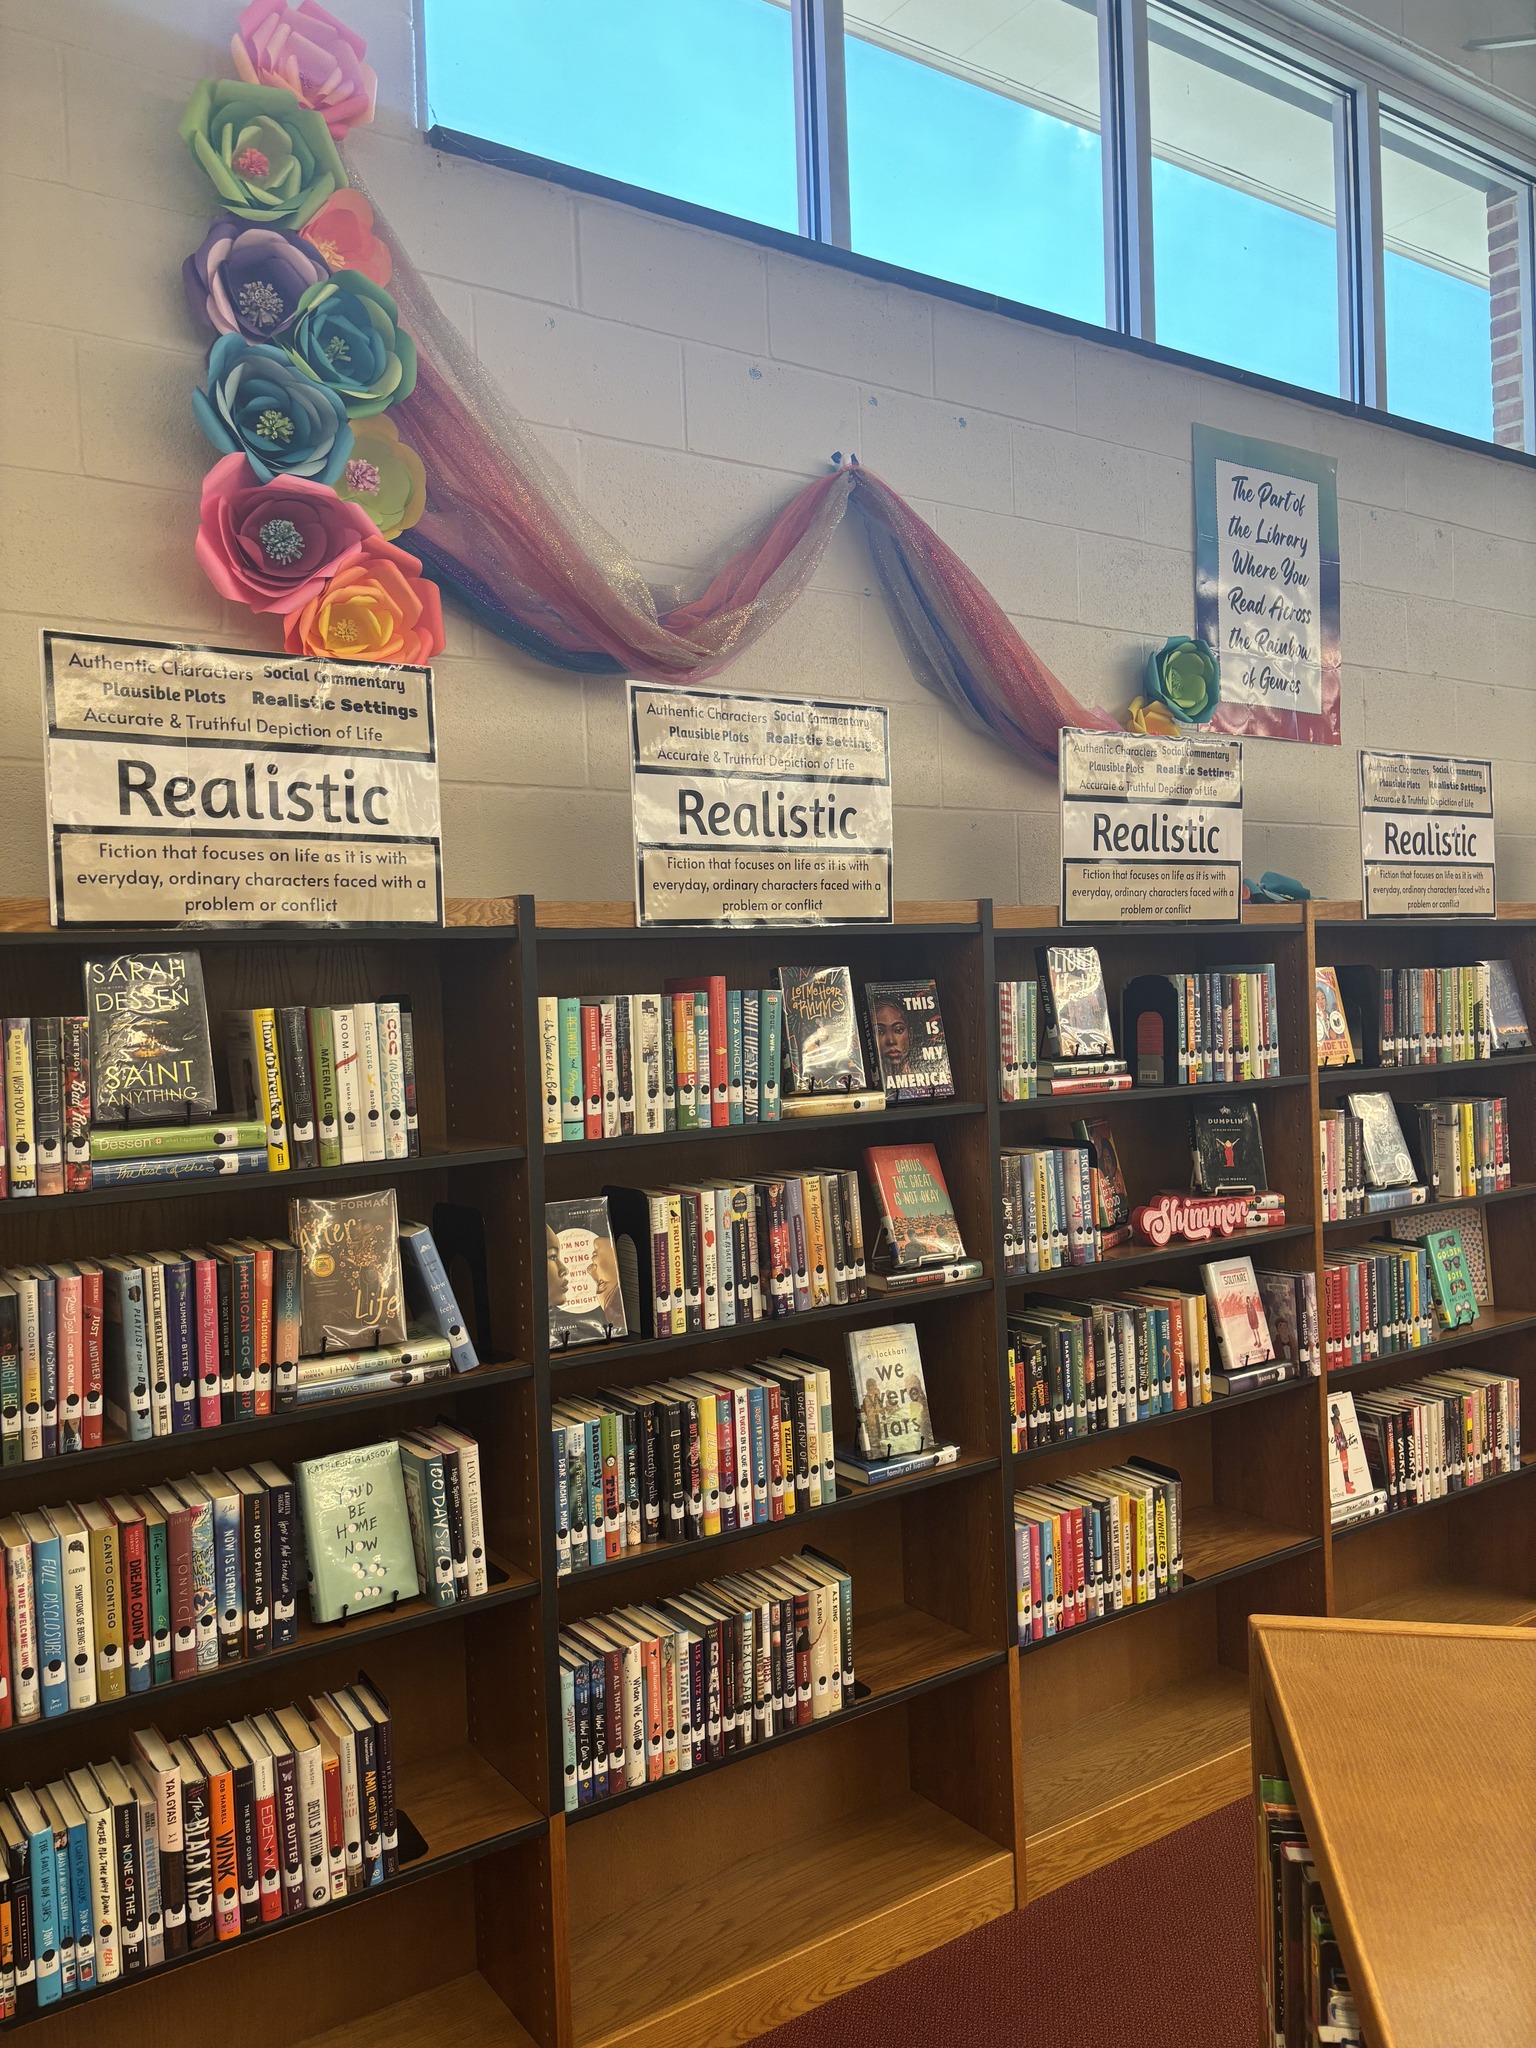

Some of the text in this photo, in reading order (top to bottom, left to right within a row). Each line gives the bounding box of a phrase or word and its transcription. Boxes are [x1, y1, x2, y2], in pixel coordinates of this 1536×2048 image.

[1231, 476, 1306, 516] The Part of
[1228, 515, 1307, 558] the Library
[1232, 549, 1309, 587] Where You
[1228, 586, 1312, 625] Read Across
[1228, 627, 1310, 660] the Rainbow
[69, 652, 405, 694] Authentic Characters Social Commentary
[1243, 666, 1300, 694] of Genres
[103, 682, 418, 719] Plausible Plots Realistic Settings
[84, 708, 382, 741] Accurate & Truthful Depiction of Life
[647, 703, 869, 729] Authentic Characters Social Commentary
[670, 727, 878, 752] Plausible Plots Realistic Settings
[658, 750, 854, 770] Accurate & Truthful Depiction of Life
[118, 759, 389, 825] Realistic
[679, 789, 857, 839] Realistic
[1094, 813, 1220, 853] Realistic
[1385, 822, 1476, 856] Realistic
[100, 843, 407, 865] Fiction that focuses on life as it is with
[668, 857, 869, 871] Fiction that focuses on life as it is with
[77, 870, 426, 889] everyday, ordinary characters faced with a
[653, 879, 881, 893] everyday, ordinary characters faced with a
[1083, 869, 1110, 880] Fiction
[1112, 870, 1128, 880] that
[1130, 870, 1159, 880] focuses
[1172, 870, 1184, 880] life
[1196, 870, 1201, 881] it
[1203, 870, 1209, 881] is
[1211, 870, 1225, 881] with
[185, 896, 337, 915] problem or conflict
[722, 900, 823, 913] problem or conflict
[1121, 905, 1152, 916] problem
[1165, 905, 1191, 914] conflict
[92, 958, 185, 983] SARAH
[96, 988, 189, 1012] DESSEN
[904, 997, 935, 1010] THIS
[341, 1015, 350, 1049] ROOM
[926, 1022, 939, 1034] IS
[922, 1047, 943, 1060] MY
[106, 1060, 193, 1089] SAINT
[262, 1020, 283, 1111] how to break
[320, 1049, 332, 1099] MATERIAL
[887, 1073, 948, 1089] AMERICA
[108, 1087, 198, 1106] ANYTHING
[100, 1136, 152, 1151] Dessen
[895, 1159, 922, 1172] DARIUS
[892, 1174, 932, 1189] THE GREAT
[300, 1199, 389, 1214] GAYLE FORMAN
[893, 1189, 940, 1206] IS NOT OKAY
[1141, 1198, 1249, 1244] Shimmer
[300, 1218, 356, 1253] After
[561, 1240, 589, 1250] I'M NOT
[564, 1254, 589, 1264] DYING
[1437, 1248, 1461, 1260] GOLDEN
[1224, 1273, 1247, 1285] SOLITAIRE
[1448, 1271, 1462, 1281] BOYS
[355, 1286, 400, 1325] Life
[567, 1296, 597, 1306] TONIGHT
[876, 1348, 907, 1359] lockhart
[875, 1363, 904, 1381] we
[307, 1446, 393, 1475] KATHLEEN GLASGOW
[886, 1465, 904, 1477] family
[348, 1502, 366, 1519] BE
[337, 1517, 377, 1539] HOME
[344, 1537, 378, 1558] NOW
[103, 1535, 116, 1629] CANTO CONTIGO
[129, 1559, 142, 1599] DREAM
[41, 1558, 61, 1656] FULL DISCLOSURE
[165, 1778, 176, 1825] YAA GYASI
[219, 1794, 227, 1825] HARRELL
[216, 1830, 236, 1881] WINK
